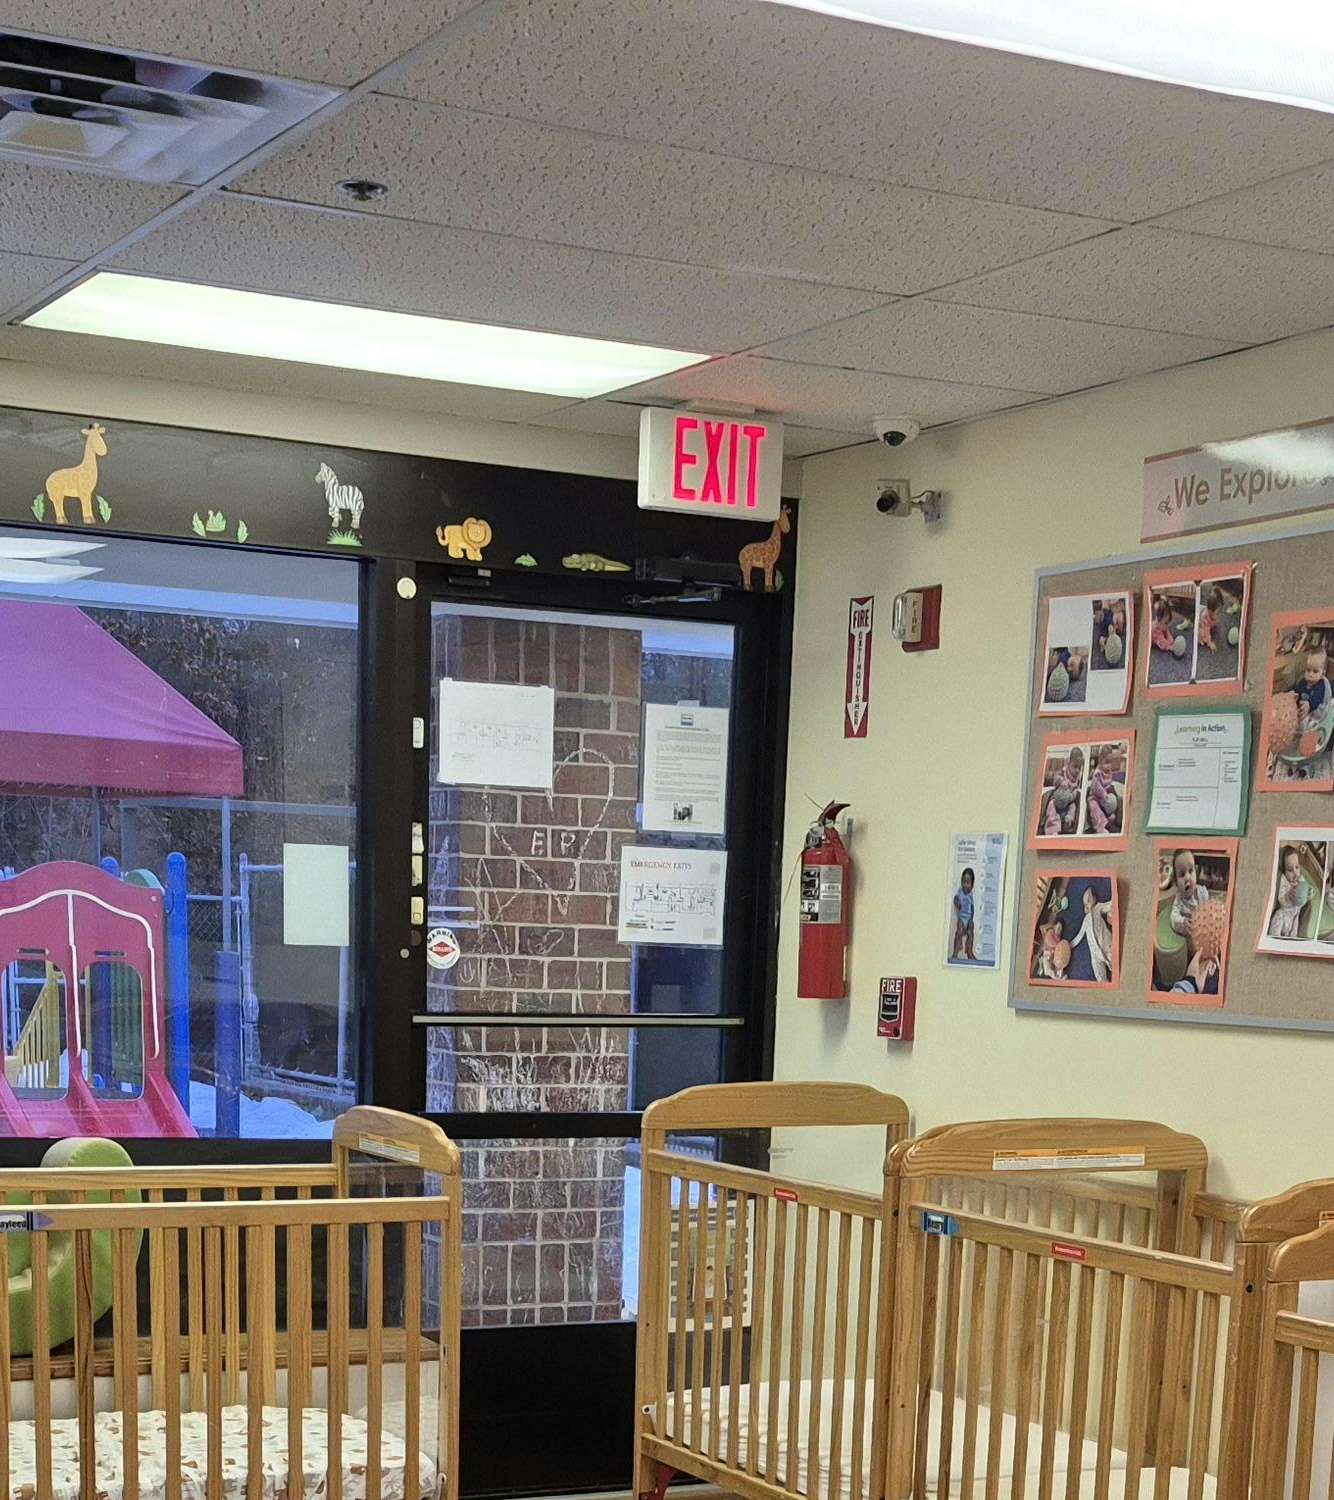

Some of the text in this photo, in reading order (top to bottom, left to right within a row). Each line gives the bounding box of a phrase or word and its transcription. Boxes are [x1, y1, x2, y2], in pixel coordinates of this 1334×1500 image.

[673, 416, 766, 507] EXIT
[1174, 474, 1210, 509] We
[853, 608, 870, 629] FIRE
[631, 860, 671, 870] EMERGENCY
[882, 980, 902, 993] FIRE
